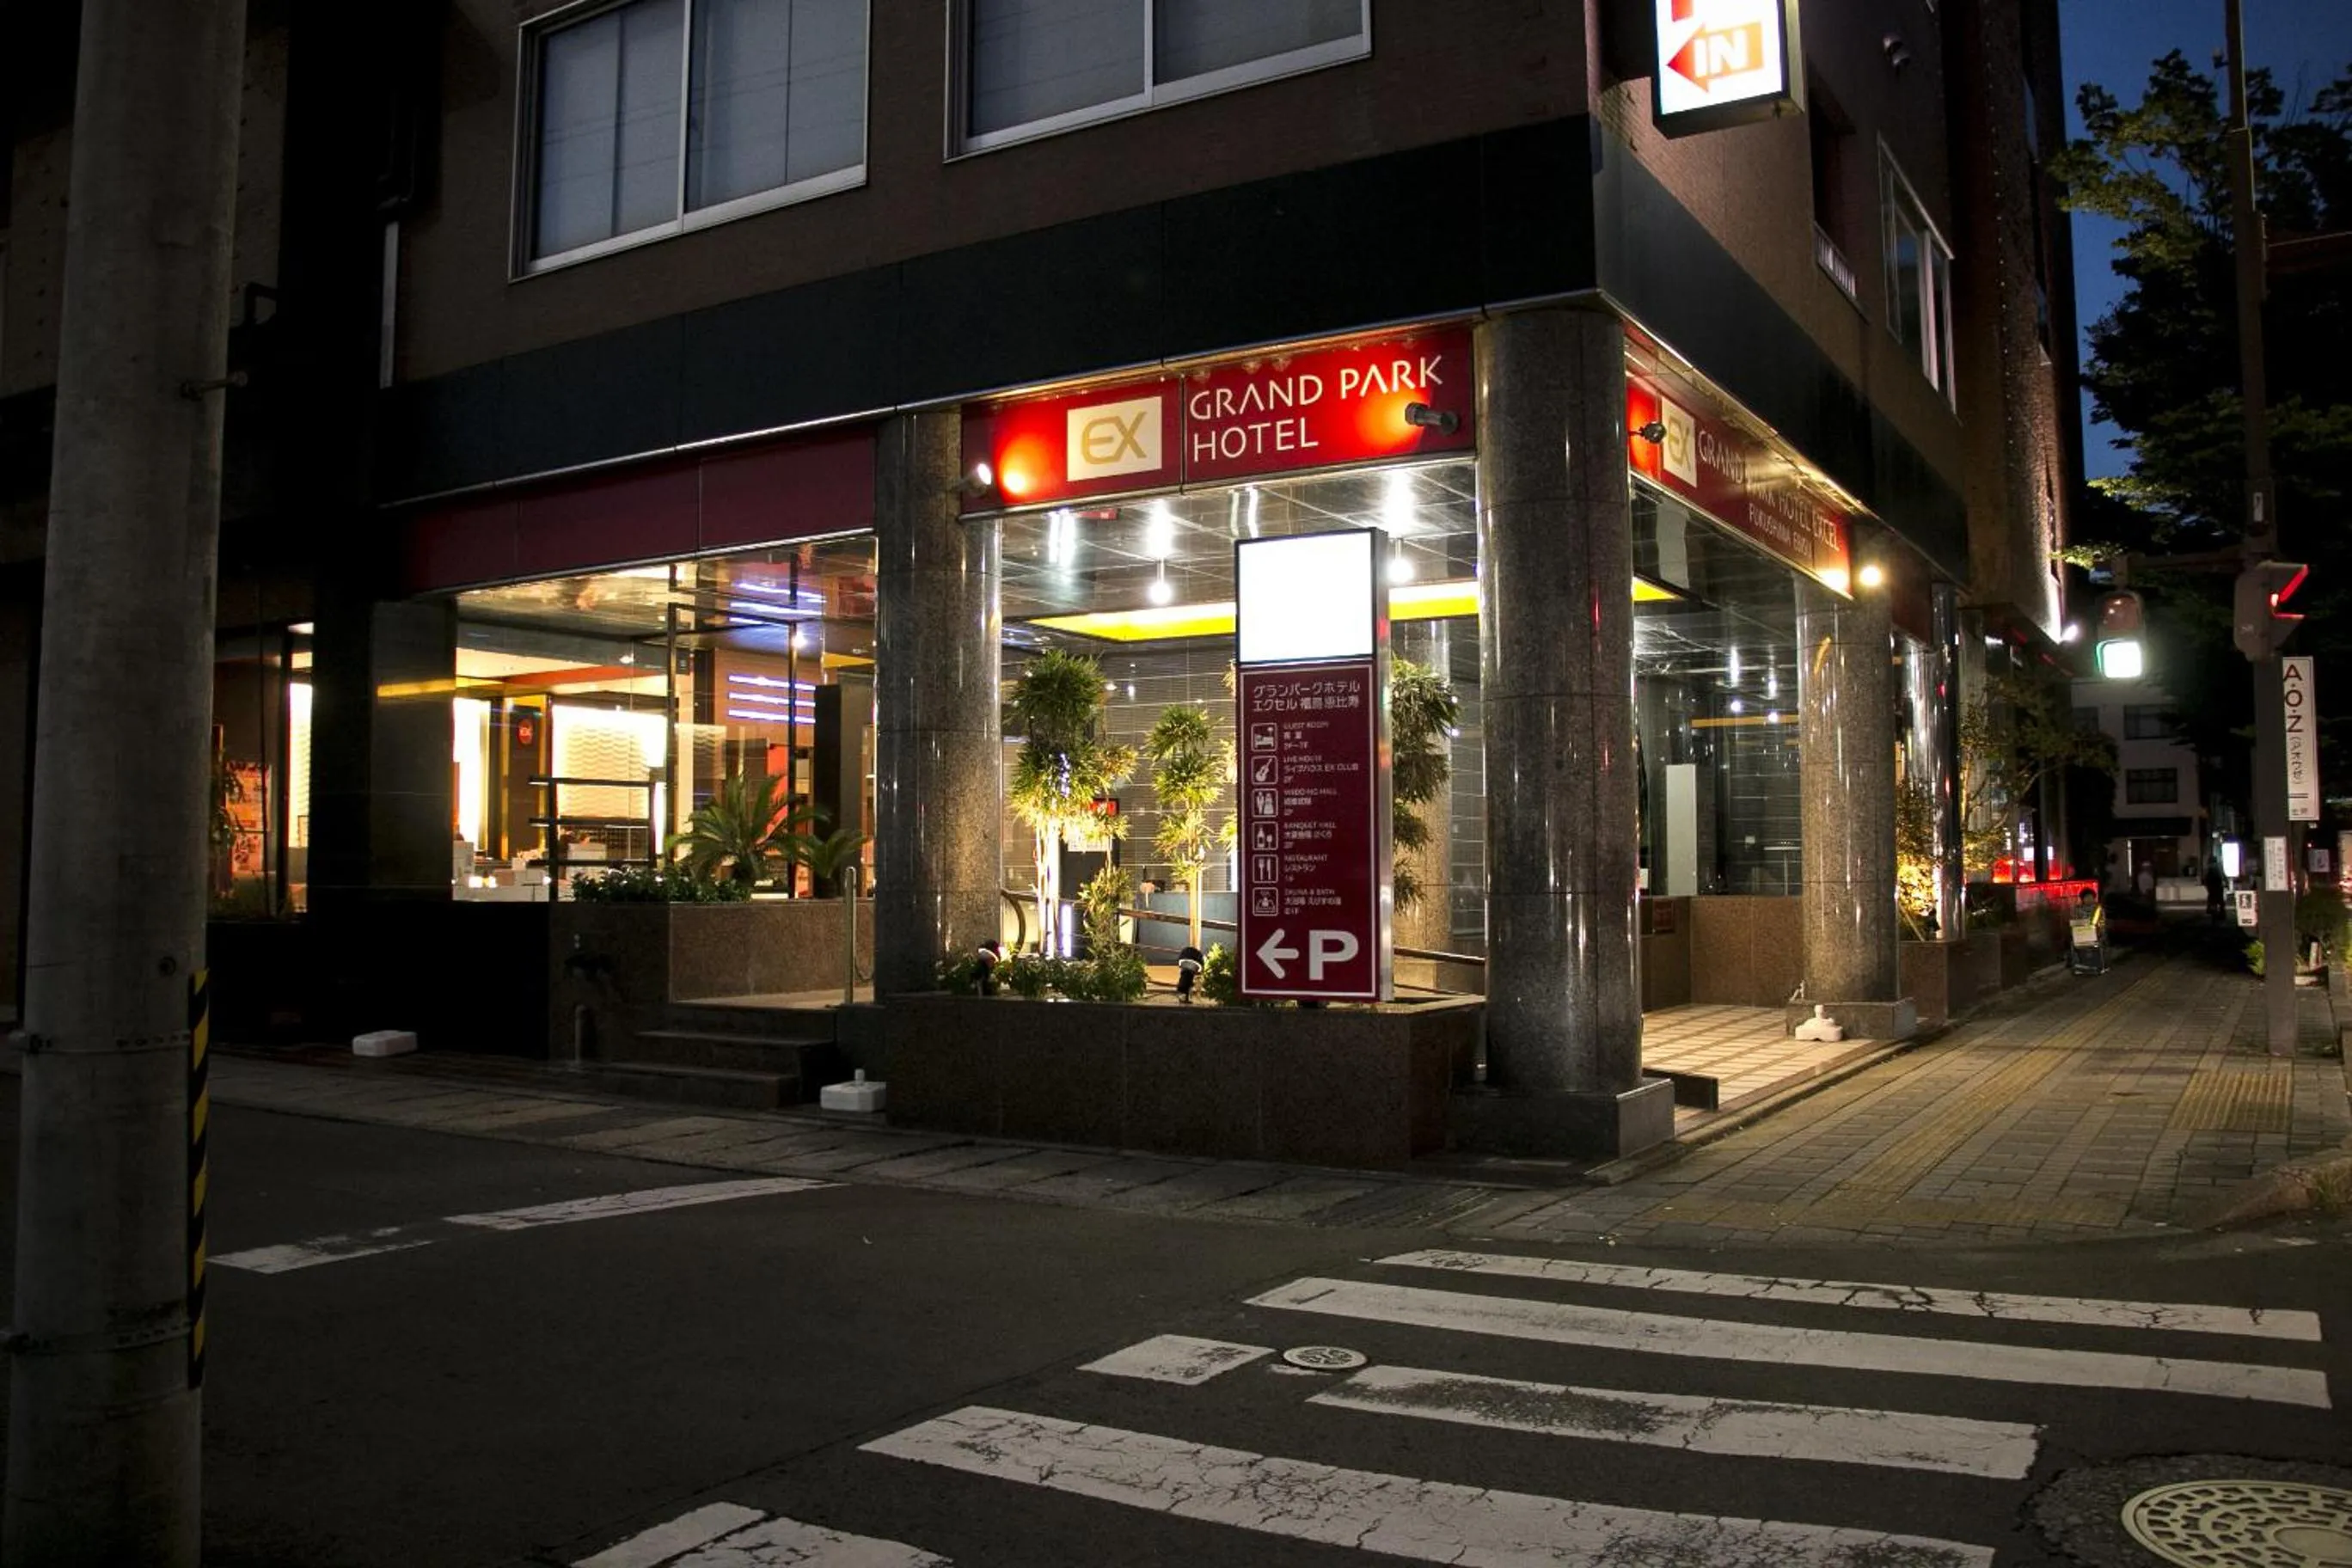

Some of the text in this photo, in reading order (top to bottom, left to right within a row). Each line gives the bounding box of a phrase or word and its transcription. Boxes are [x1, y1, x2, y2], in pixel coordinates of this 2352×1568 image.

[1694, 28, 1747, 78] IN
[1190, 354, 1443, 420] GRAND PARK
[1081, 410, 1148, 464] EX
[1194, 417, 1319, 462] HOTEL
[1698, 429, 1744, 484] GRAND
[1779, 487, 1811, 532] HOTEL
[1308, 929, 1358, 980] P
